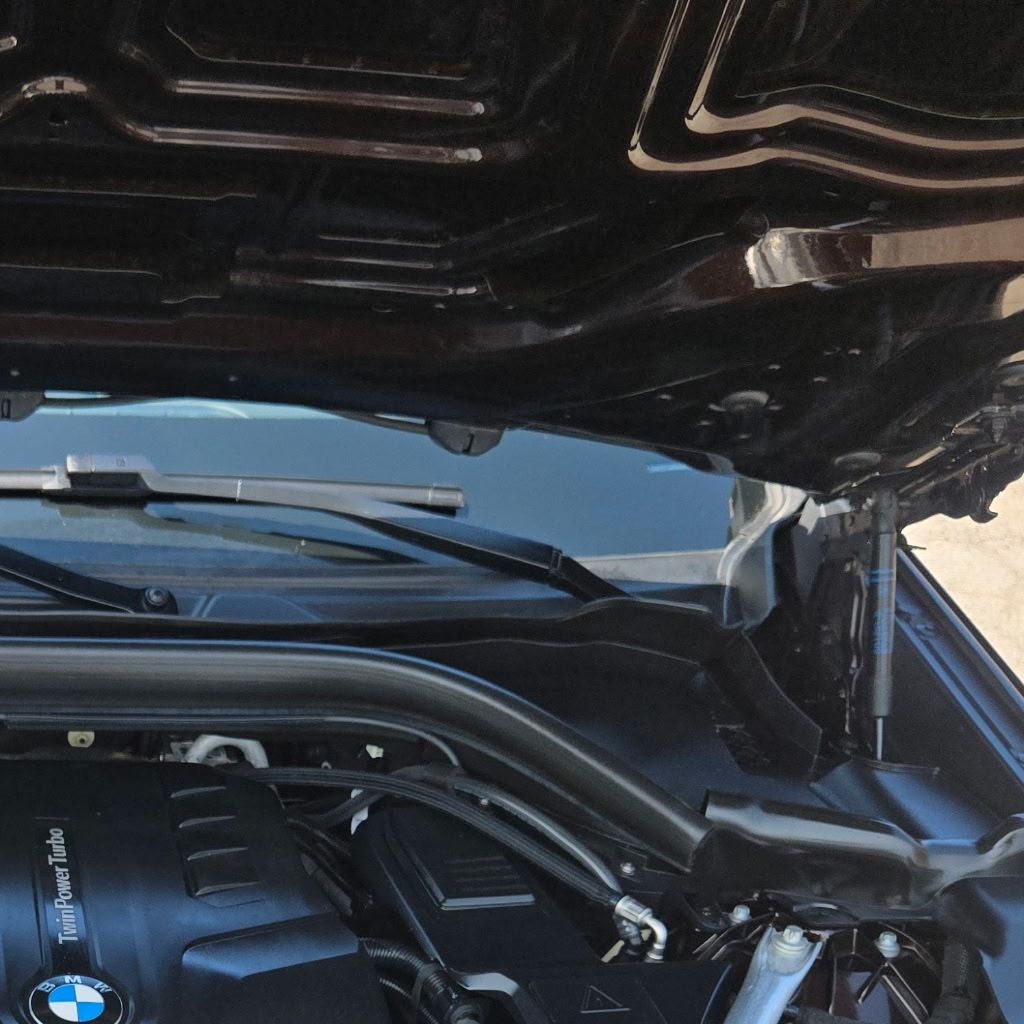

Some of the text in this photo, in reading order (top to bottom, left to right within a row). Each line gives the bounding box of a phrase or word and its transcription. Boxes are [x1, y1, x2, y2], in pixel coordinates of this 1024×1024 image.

[45, 827, 79, 945] TwinPower Turbo
[36, 974, 113, 994] BMW
